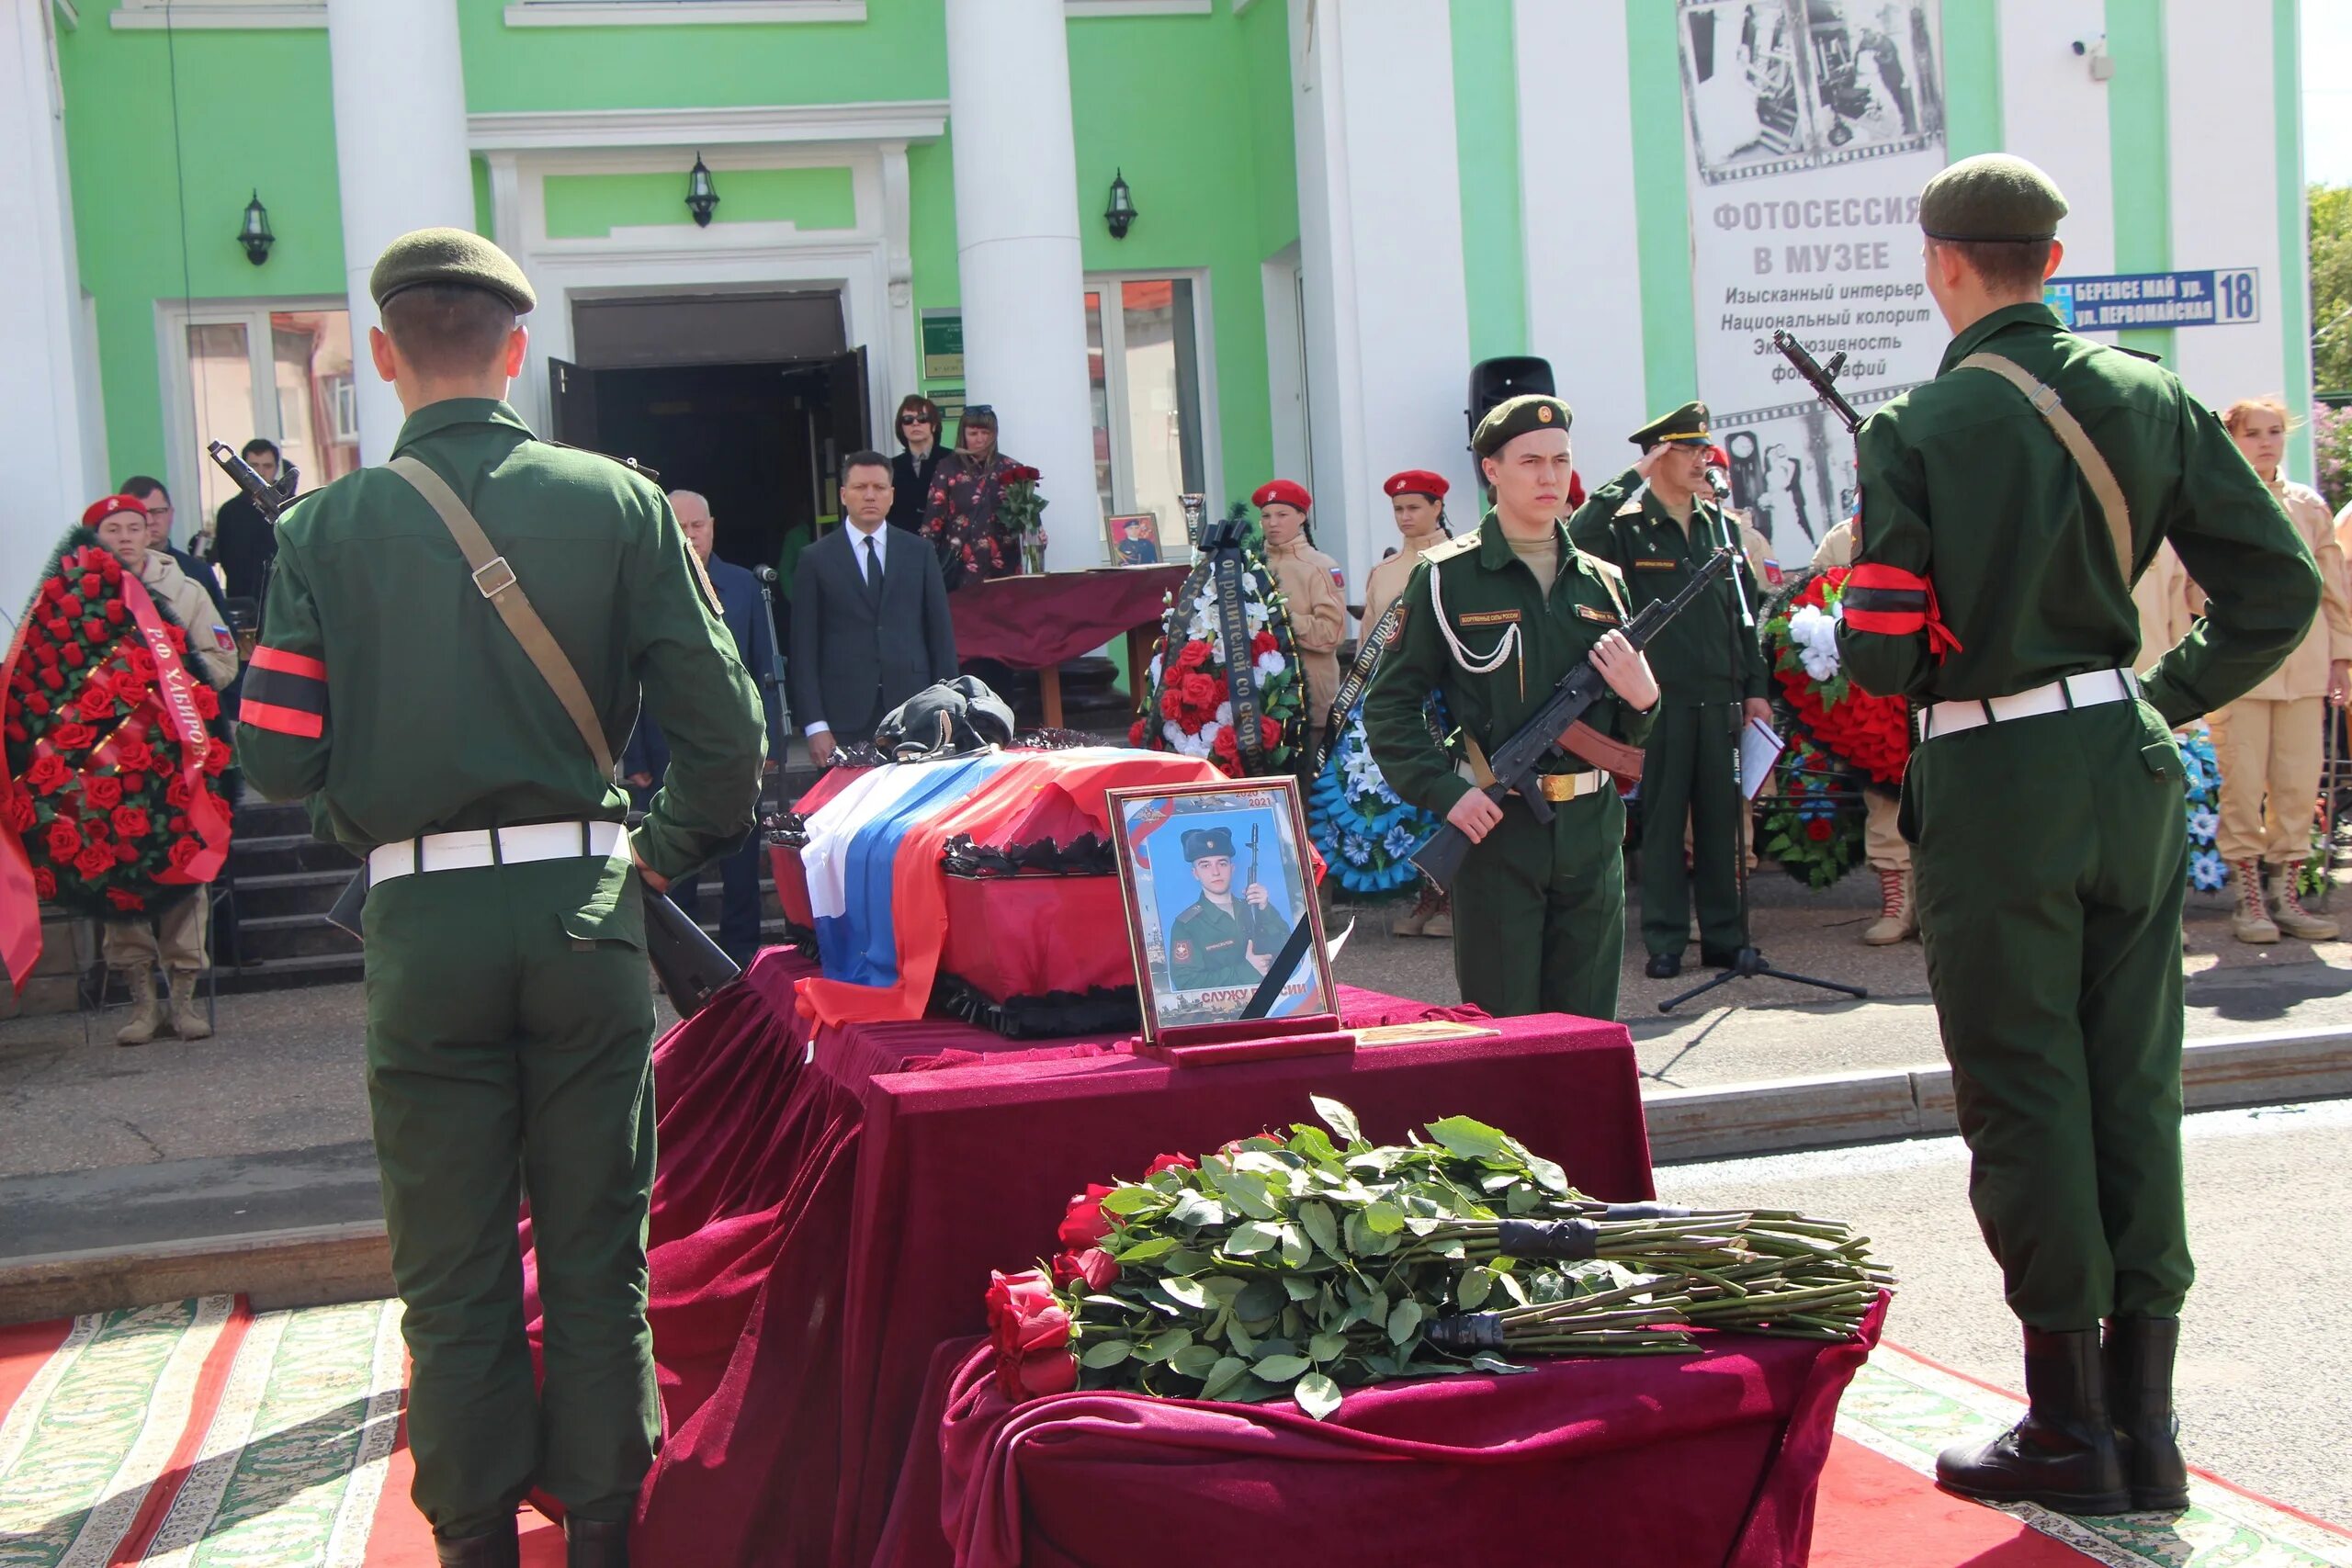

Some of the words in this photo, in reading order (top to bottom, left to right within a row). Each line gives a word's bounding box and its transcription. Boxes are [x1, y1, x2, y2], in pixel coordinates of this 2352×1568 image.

[1713, 196, 1920, 231] ФОТОСЕССИЯ
[1754, 246, 1772, 275] В
[1786, 242, 1890, 273] МУЗЕЕ
[1725, 284, 1834, 304] Изысканный
[1839, 283, 1924, 302] интерьер
[2075, 280, 2140, 301] БЕРЕНСЕ
[2142, 276, 2176, 299] МАЙ
[2180, 281, 2204, 299] ур.
[2220, 273, 2253, 319] 18
[1721, 309, 1850, 332] Национальный
[1856, 308, 1930, 327] колорит
[2075, 310, 2098, 327] ул.
[2099, 299, 2212, 324] ПЕРВОМАЙСКАЯ
[1772, 359, 1886, 384] фоафий
[1223, 580, 1251, 672] родителей
[1236, 678, 1250, 696] со
[1249, 797, 1272, 807] 2021
[1201, 988, 1248, 1003] СЛУЖУ
